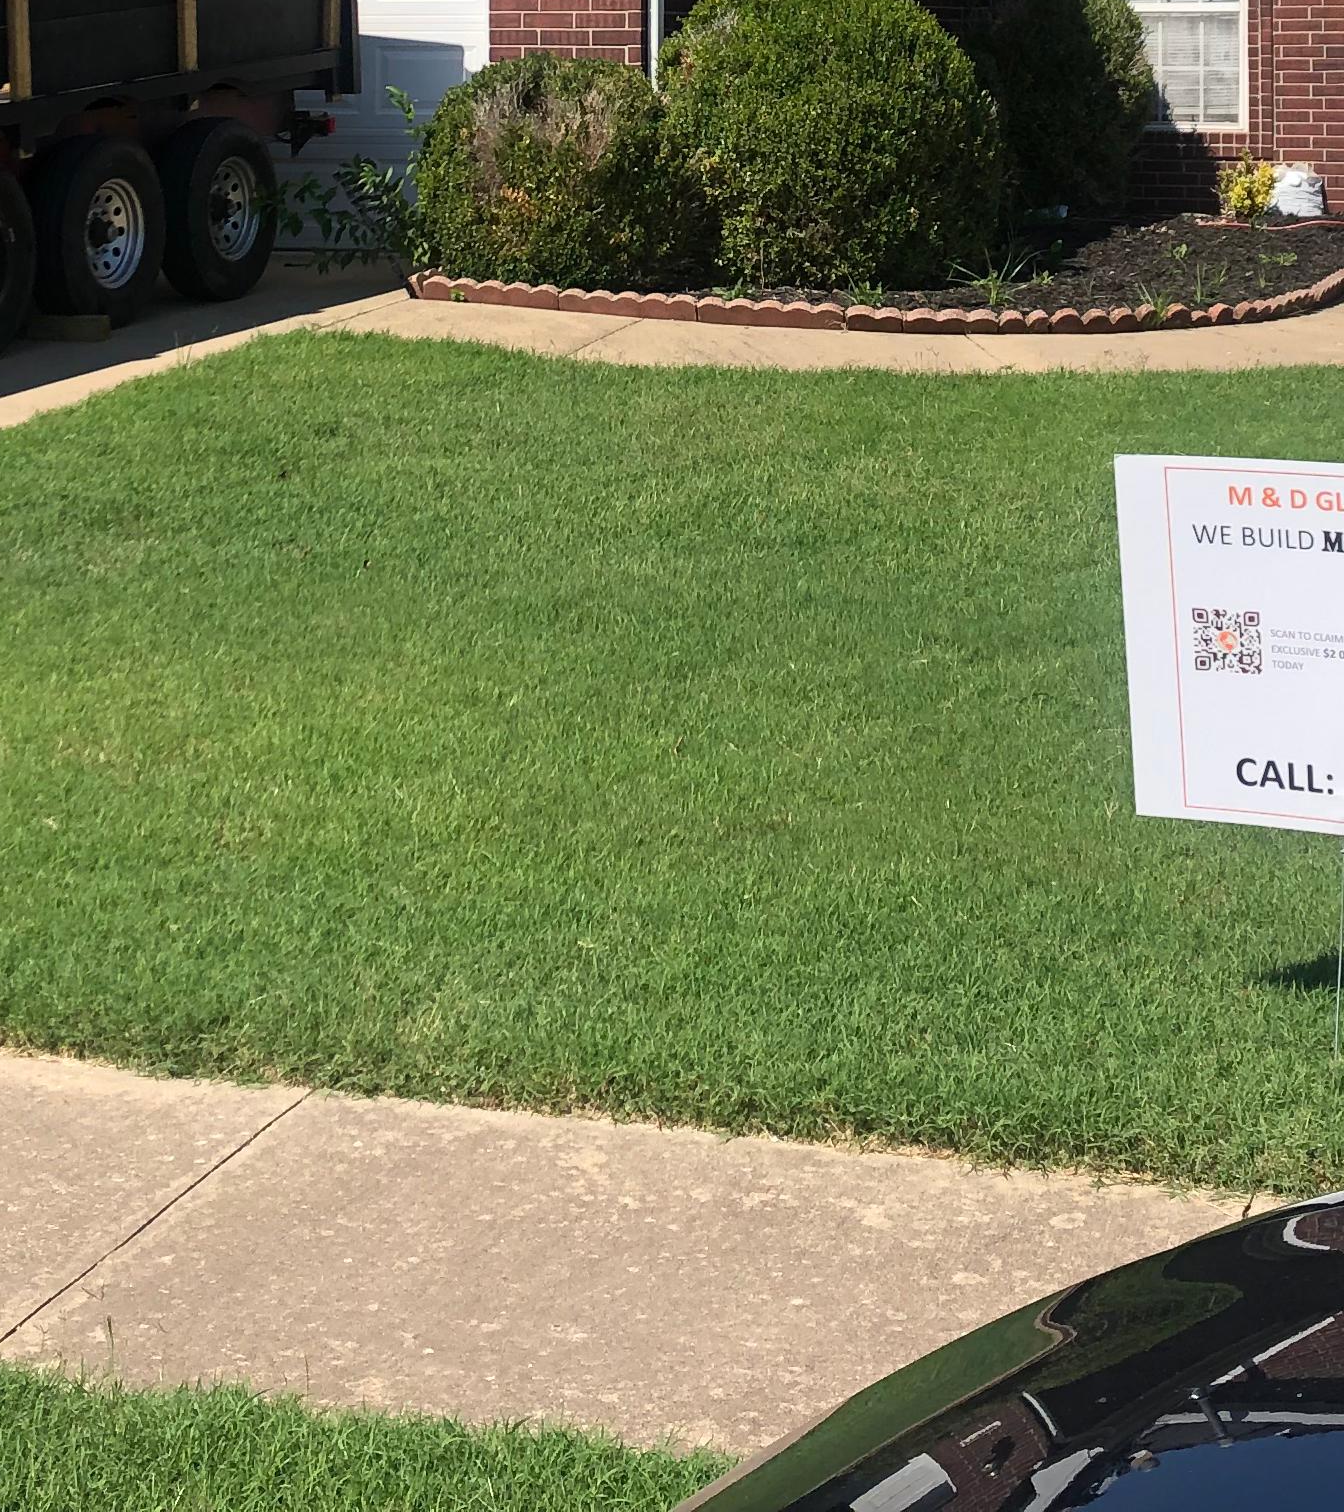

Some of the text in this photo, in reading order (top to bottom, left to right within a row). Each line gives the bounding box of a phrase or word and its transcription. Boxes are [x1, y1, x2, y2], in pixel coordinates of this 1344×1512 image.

[1227, 485, 1253, 506] M
[1261, 487, 1282, 508] &
[1290, 489, 1307, 509] D
[1192, 523, 1233, 545] WE
[1242, 526, 1315, 550] BUILD
[1270, 629, 1296, 639] SCAN
[1298, 631, 1312, 641] TO
[1313, 633, 1344, 643] CLAIM
[1271, 645, 1321, 658] EXCLUSIVE
[1323, 648, 1336, 659] $2
[1272, 659, 1304, 671] TODAY
[1236, 757, 1334, 796] CALL:
